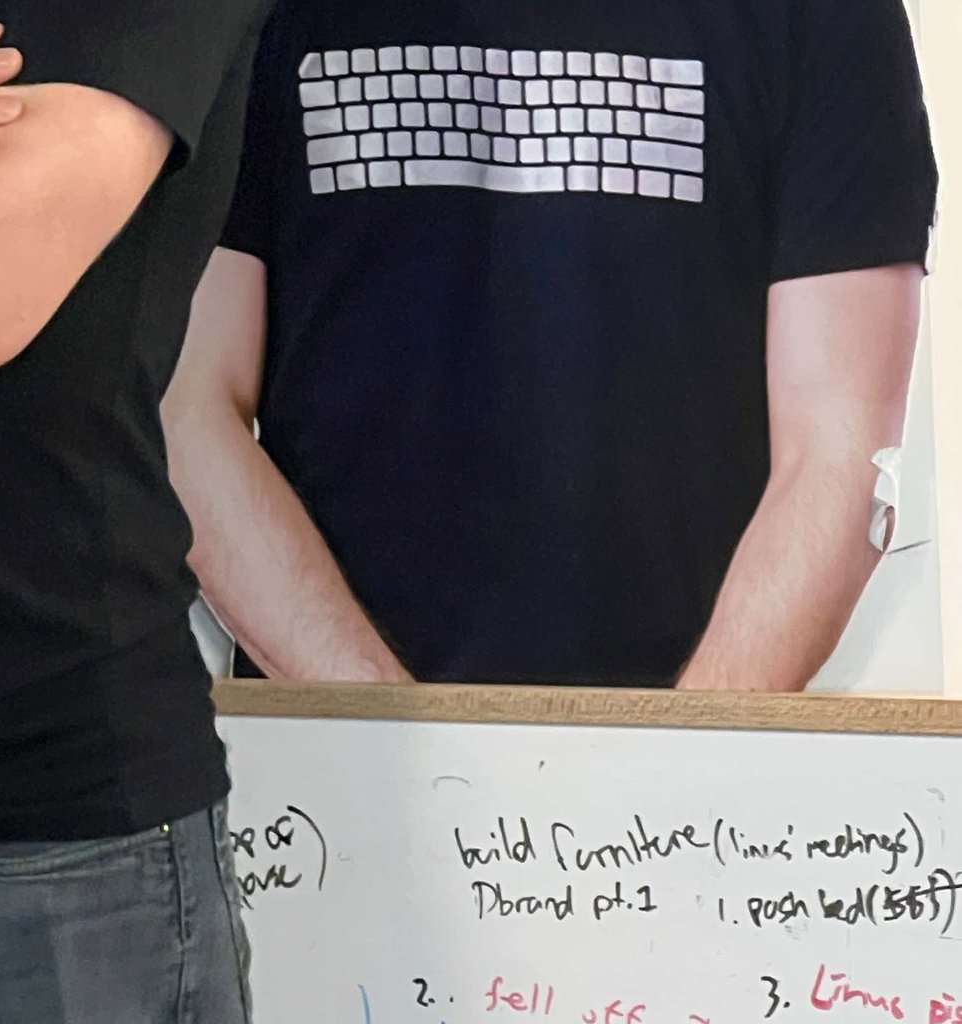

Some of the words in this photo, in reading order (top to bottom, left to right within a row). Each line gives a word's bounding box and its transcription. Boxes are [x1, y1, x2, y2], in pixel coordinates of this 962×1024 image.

[454, 816, 536, 869] build
[472, 881, 574, 920] Dbrand
[747, 890, 810, 927] push
[486, 977, 554, 1016] fell
[760, 976, 791, 1019] 3.
[810, 964, 905, 1020] Linus
